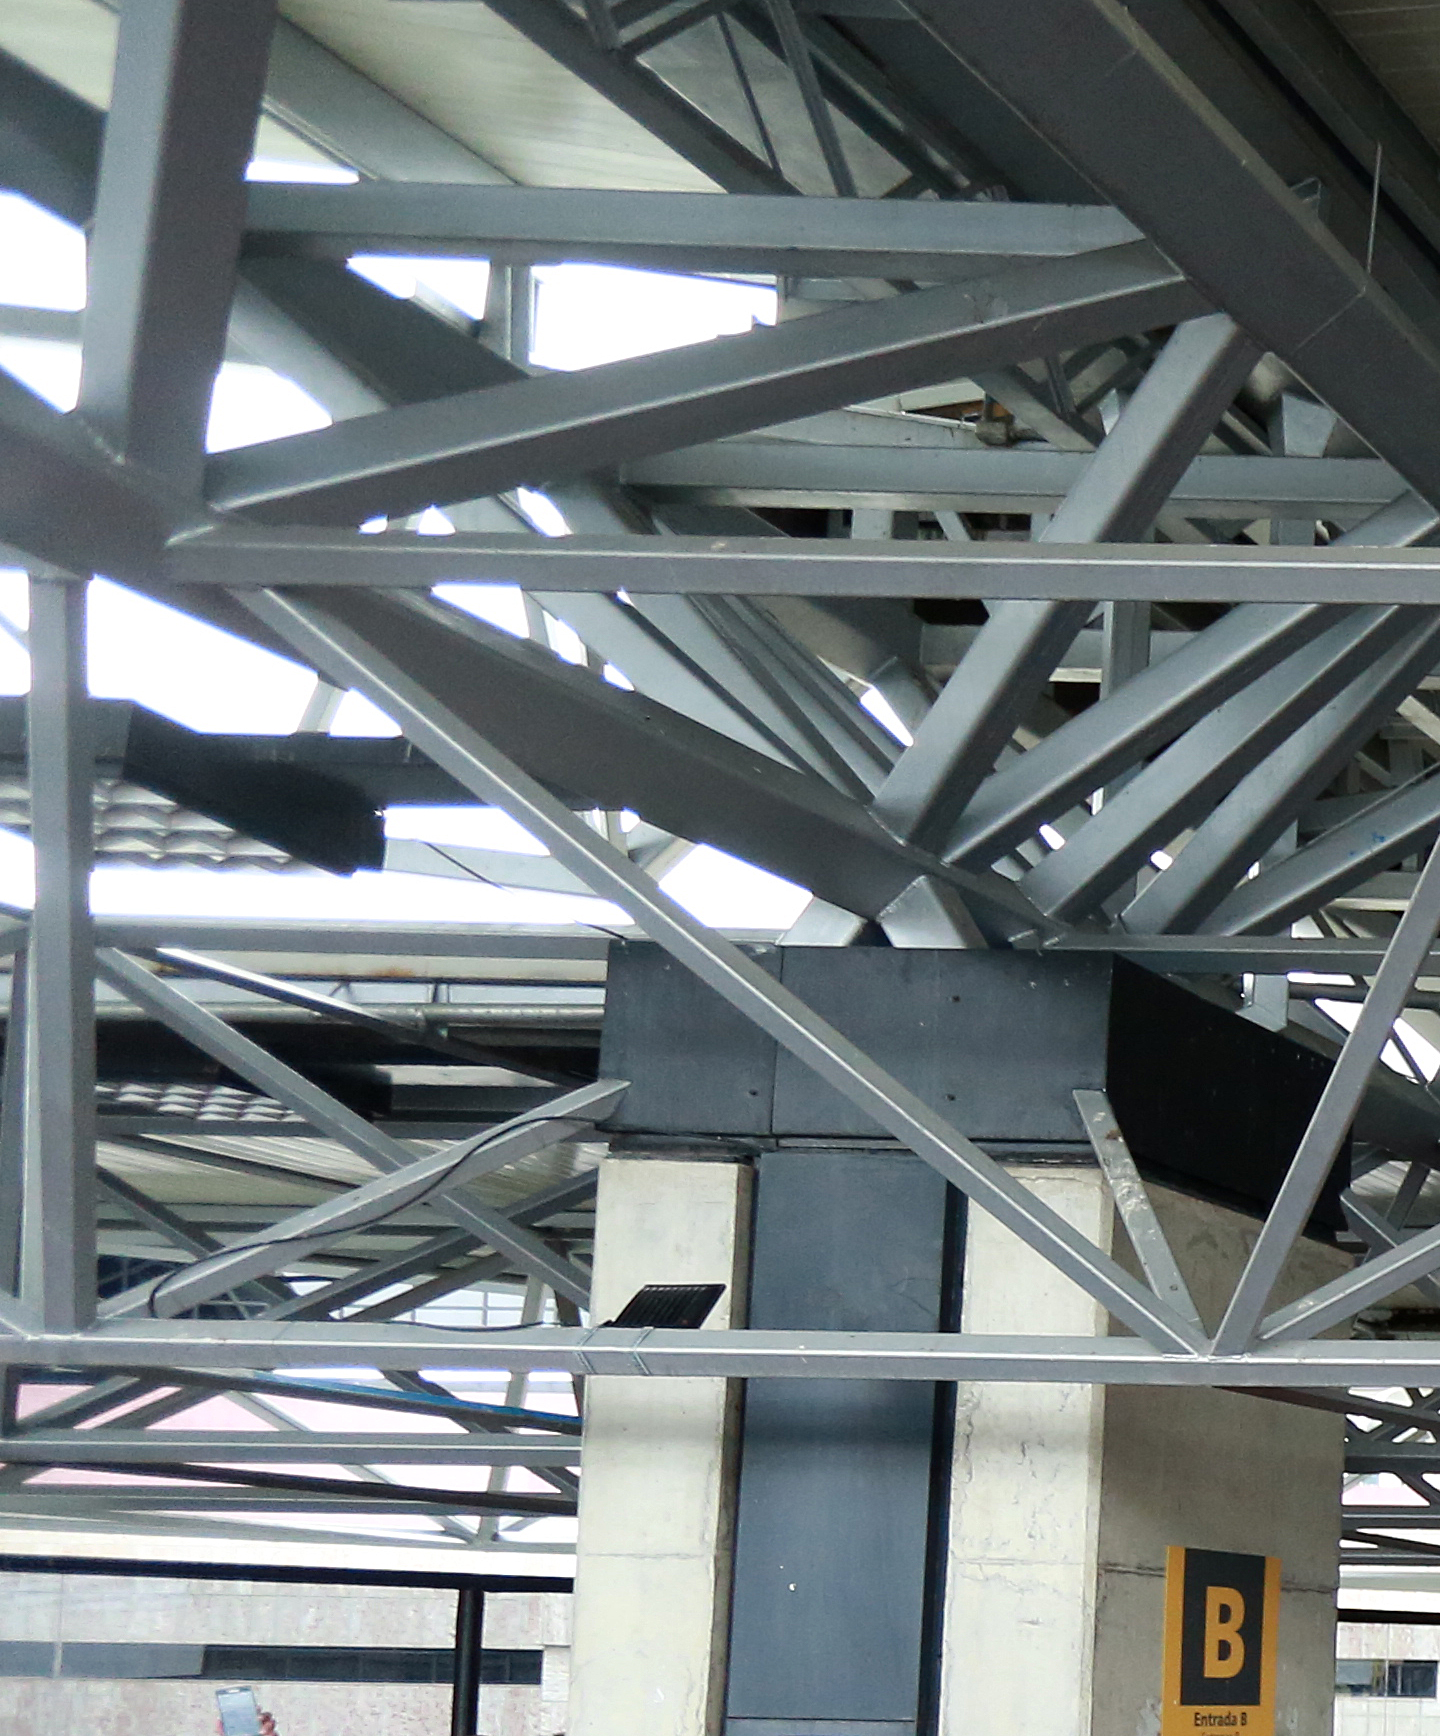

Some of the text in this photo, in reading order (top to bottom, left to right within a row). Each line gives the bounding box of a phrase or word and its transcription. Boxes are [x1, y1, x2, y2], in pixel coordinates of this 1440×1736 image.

[1204, 1585, 1246, 1679] B
[1194, 1711, 1247, 1727] Entrada B
